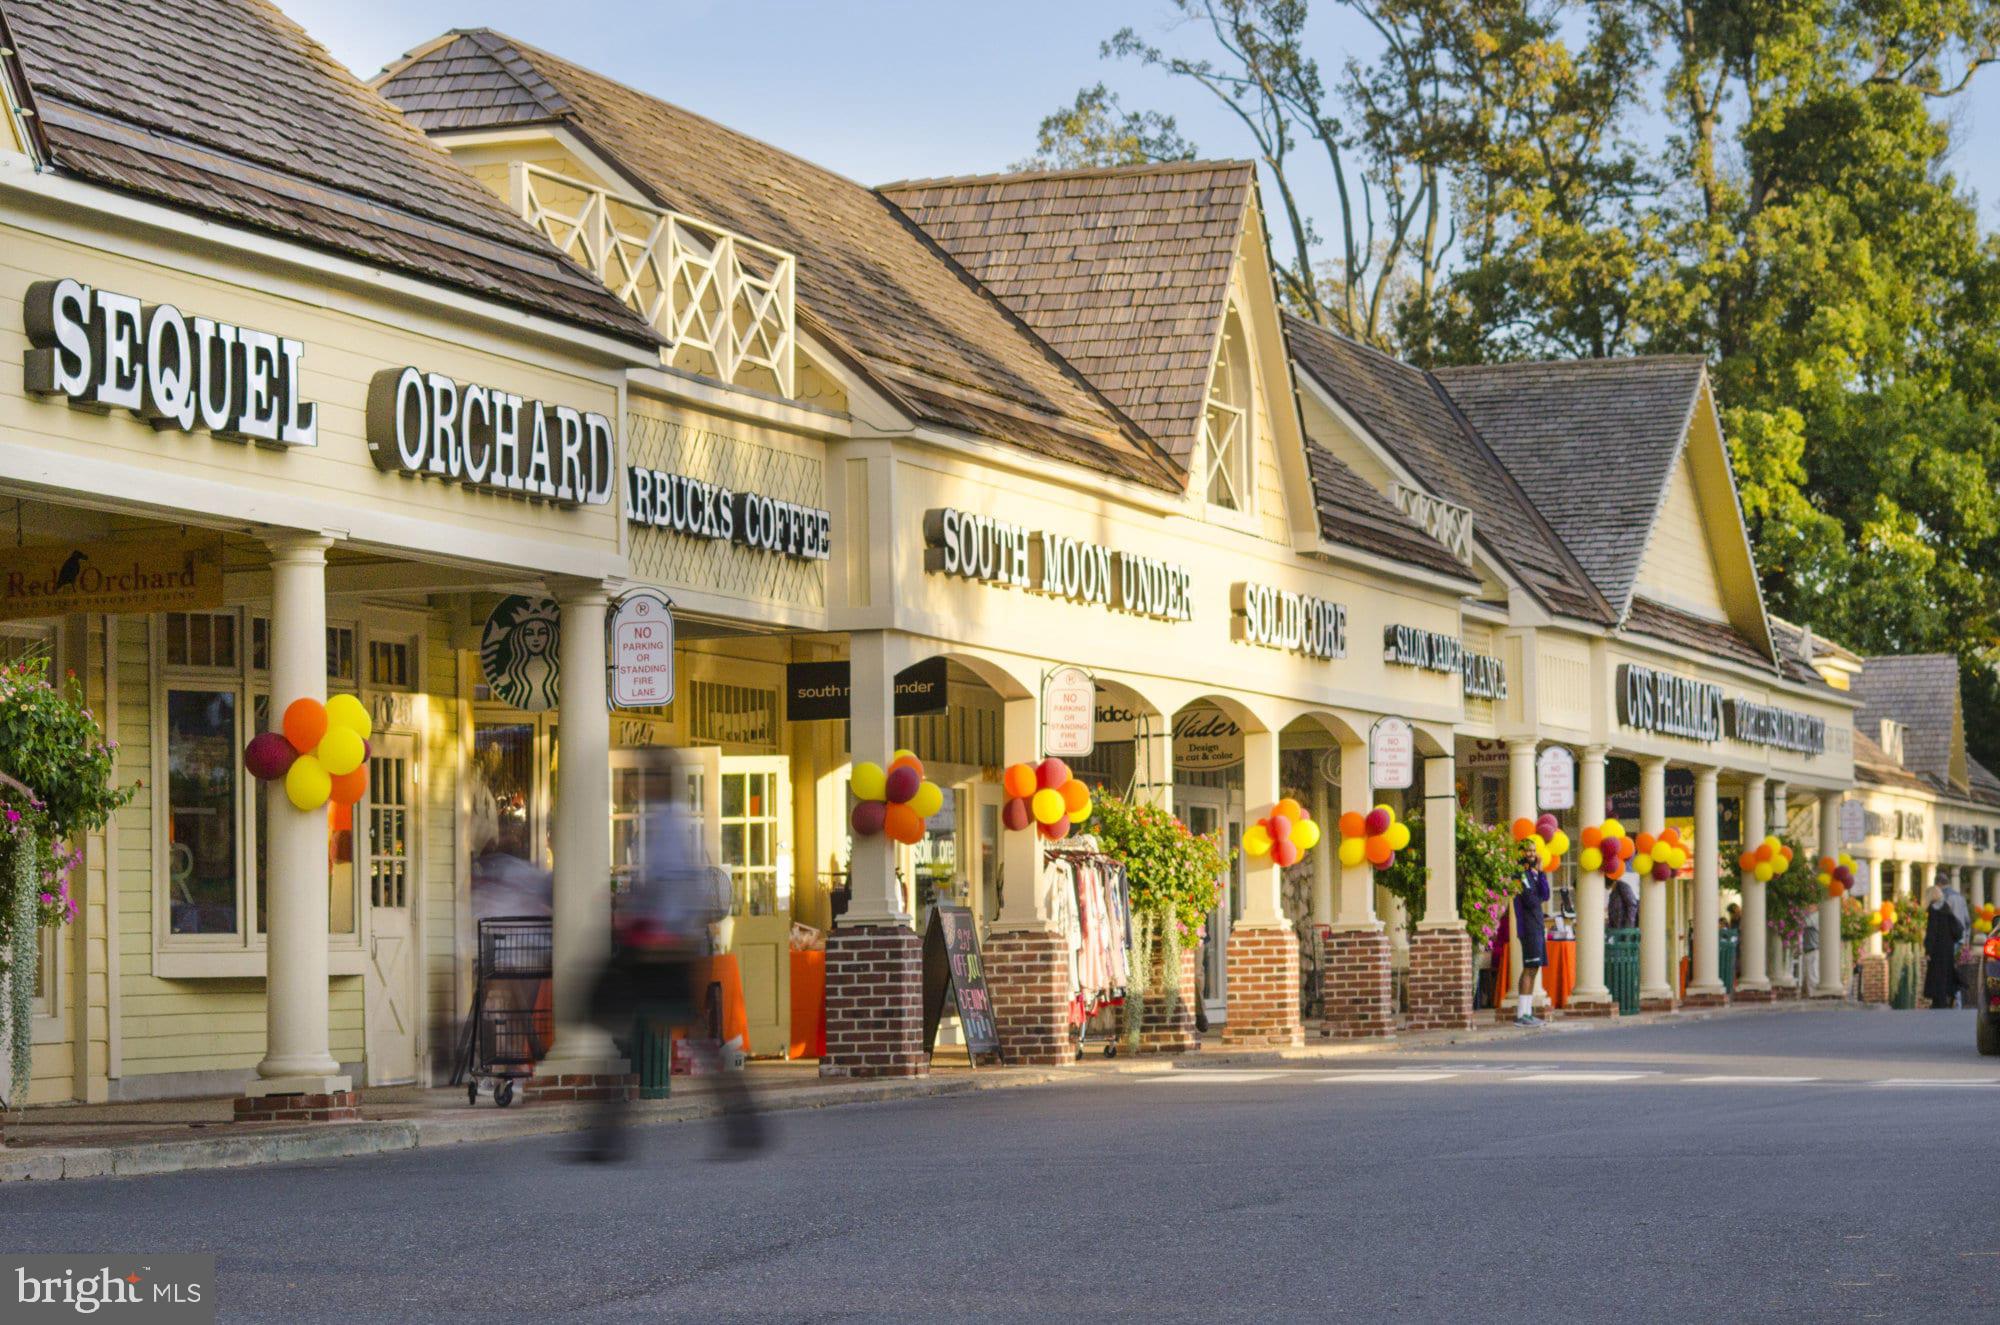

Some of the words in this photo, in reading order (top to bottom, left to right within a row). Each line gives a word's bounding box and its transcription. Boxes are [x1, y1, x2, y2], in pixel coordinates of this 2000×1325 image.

[50, 278, 318, 447] SEQUEL
[395, 366, 616, 505] ORCHARD
[745, 492, 831, 560] COFFEE
[942, 508, 1029, 587] SOUTH
[1041, 530, 1112, 604] MOON
[1120, 550, 1193, 621] UNDER
[7, 566, 57, 598] Red
[79, 558, 196, 594] Orchard
[1244, 581, 1347, 659] SOLIDCORE
[634, 627, 652, 639] NO
[622, 641, 664, 651] PARKING
[636, 653, 650, 662] OR
[620, 664, 667, 675] STANDING
[633, 676, 654, 685] FIRE
[631, 688, 656, 697] LANE
[798, 684, 841, 698] south
[1626, 663, 1653, 729] CVS
[1063, 693, 1077, 703] NO
[1188, 743, 1219, 751] Design
[1201, 753, 1209, 761] &
[1212, 752, 1233, 760] color
